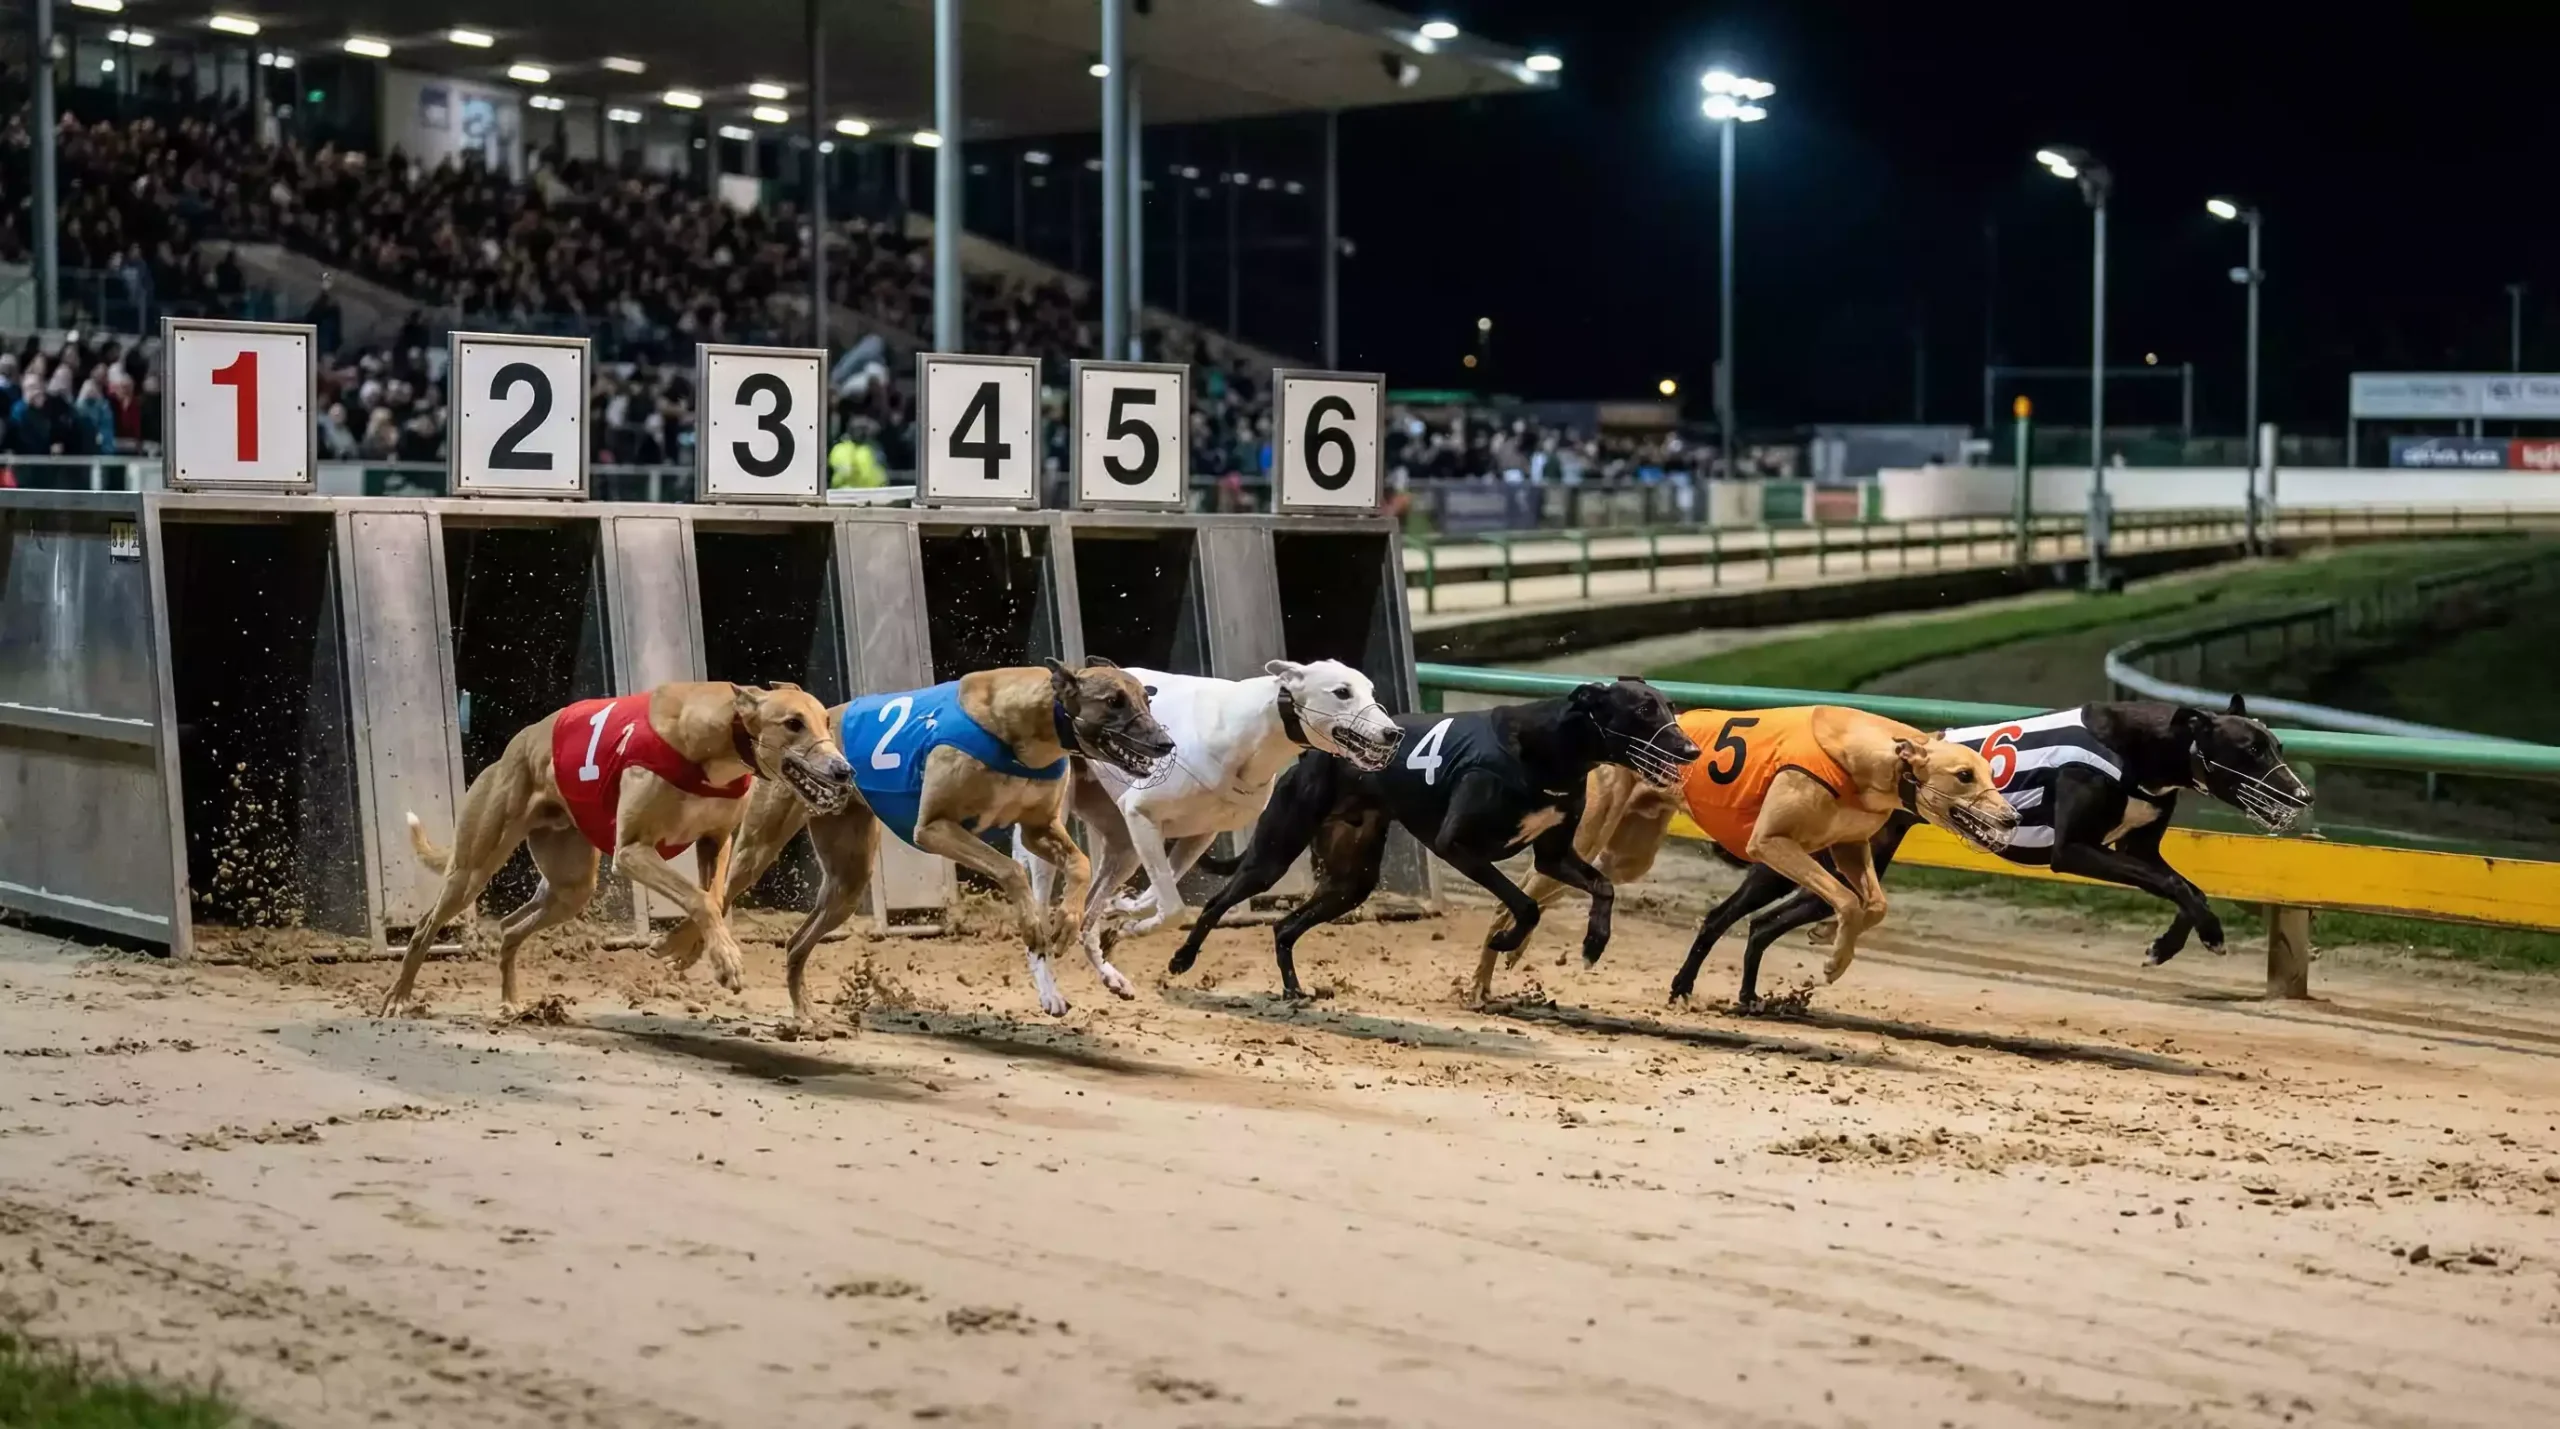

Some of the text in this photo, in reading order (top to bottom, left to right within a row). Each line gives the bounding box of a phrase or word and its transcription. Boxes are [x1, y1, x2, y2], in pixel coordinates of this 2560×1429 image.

[212, 351, 258, 462] 1
[488, 362, 553, 470] 2
[732, 373, 795, 478] 3
[949, 382, 1011, 480] 4
[1103, 387, 1160, 486] 5
[1304, 395, 1356, 491] 6
[579, 701, 617, 781] 1
[871, 696, 914, 770] 2
[1406, 717, 1455, 786] 4
[1708, 717, 1760, 786] 5
[1979, 724, 2023, 791] 6
